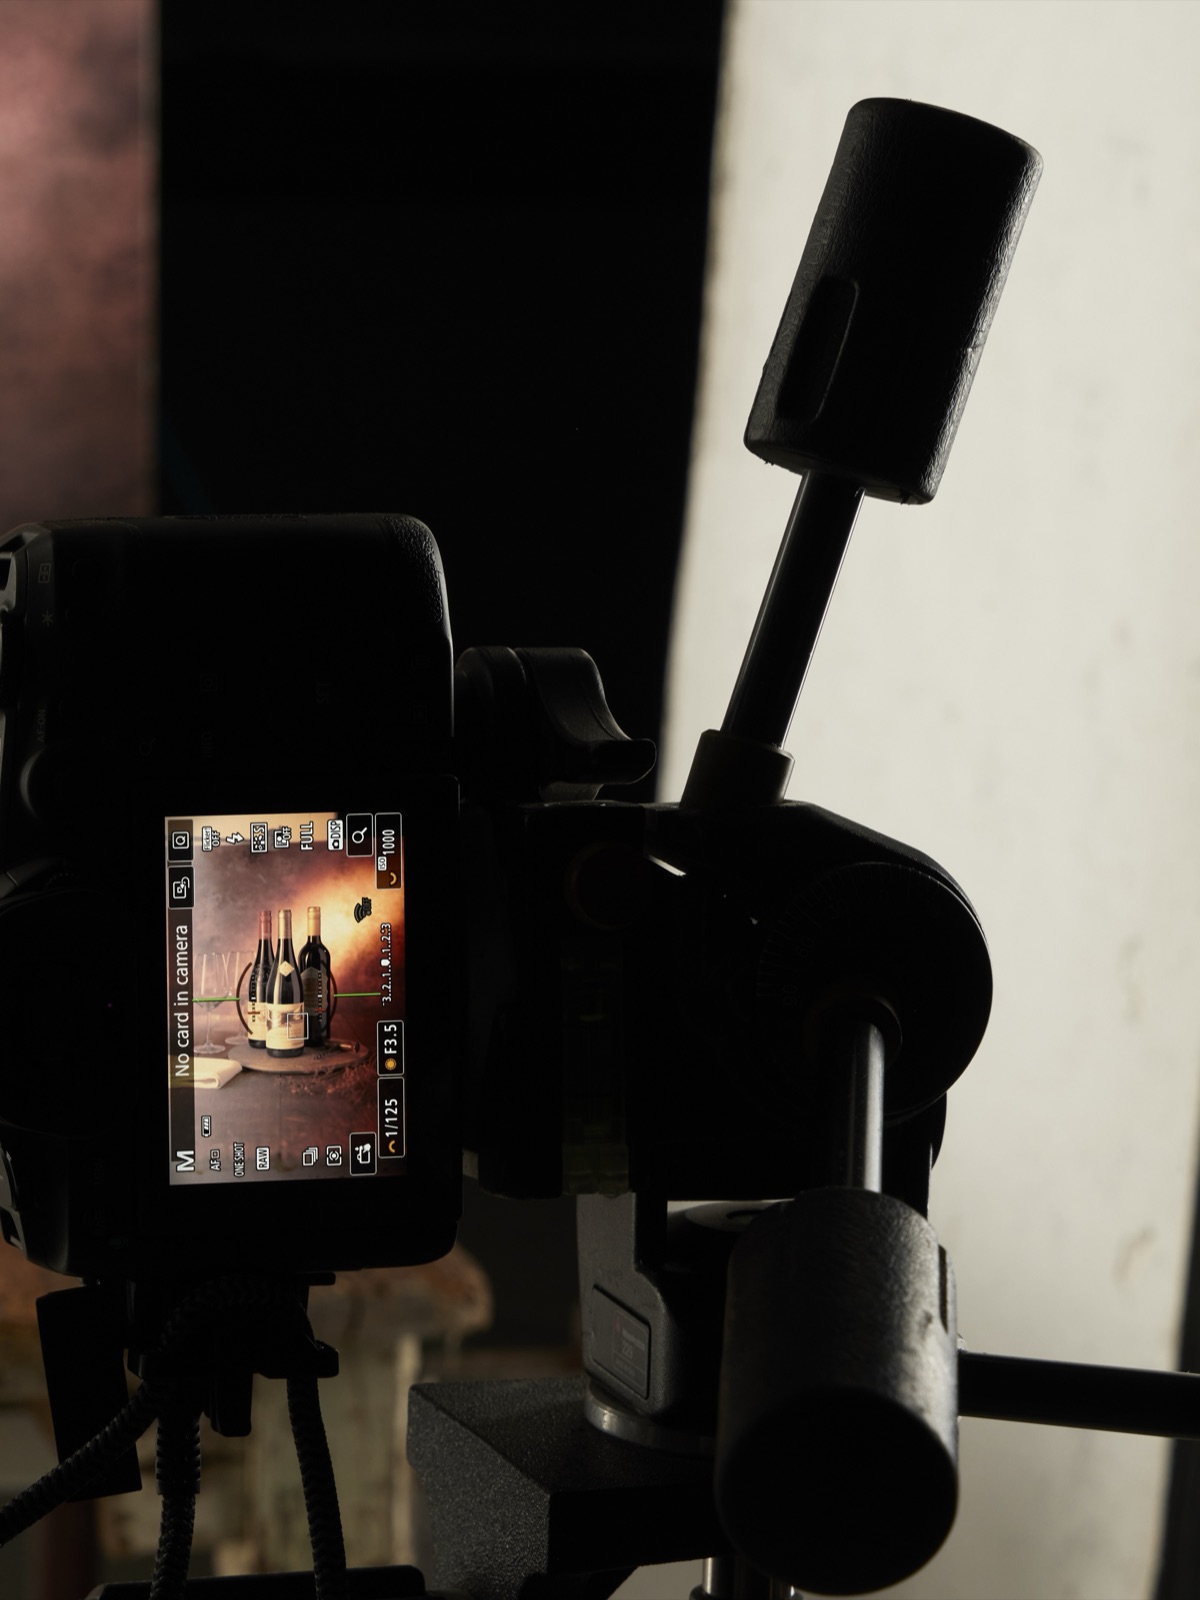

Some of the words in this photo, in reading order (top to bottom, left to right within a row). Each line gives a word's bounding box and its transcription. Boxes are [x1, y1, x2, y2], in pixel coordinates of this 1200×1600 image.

[212, 830, 220, 846] OFF
[300, 822, 314, 850] FULL
[331, 821, 341, 839] DISP
[382, 830, 395, 855] 1000
[175, 924, 188, 985] camera
[173, 991, 188, 1006] in
[174, 1012, 189, 1048] card
[384, 1024, 397, 1054] F3.5
[175, 1053, 190, 1076] No
[384, 1098, 399, 1137] 1/125
[176, 1150, 194, 1172] M
[234, 1142, 244, 1160] SHOT
[259, 1148, 268, 1169] RAW
[211, 1160, 220, 1171] AF
[234, 1160, 245, 1177] ONE
